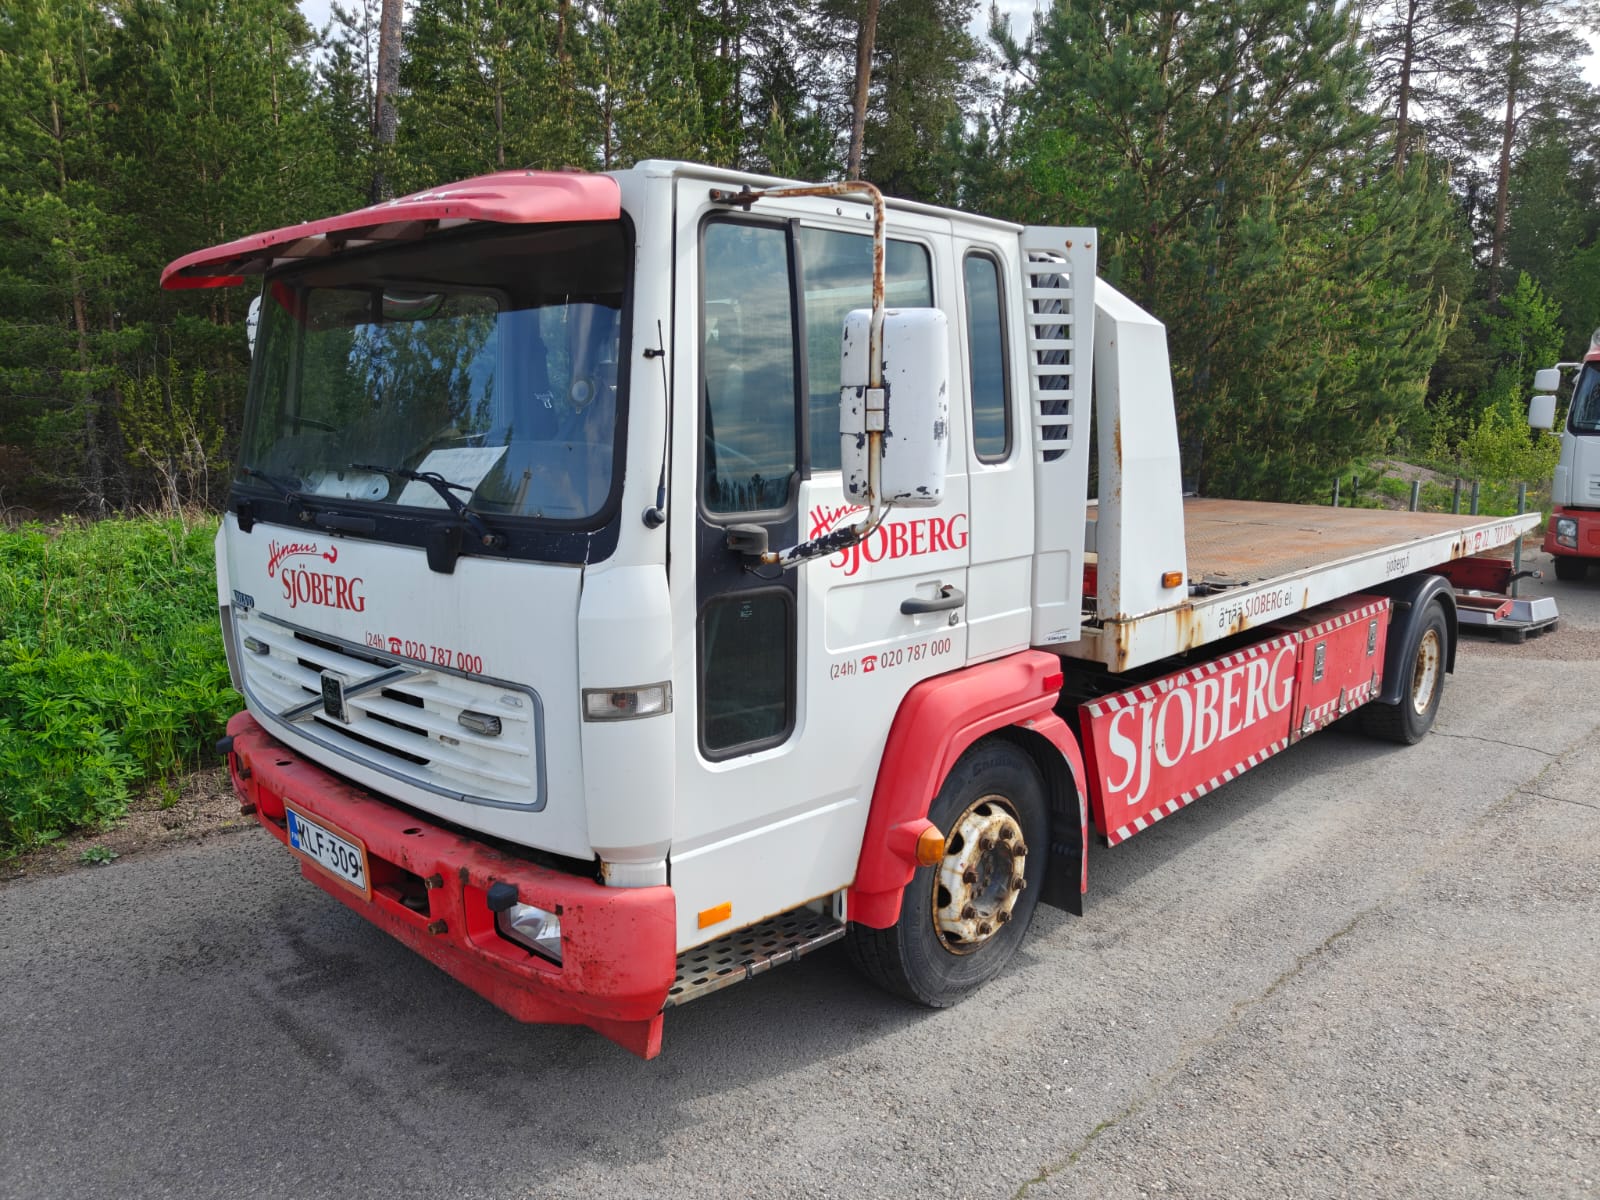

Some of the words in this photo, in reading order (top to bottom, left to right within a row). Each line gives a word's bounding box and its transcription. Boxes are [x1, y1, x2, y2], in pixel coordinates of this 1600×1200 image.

[268, 539, 317, 578] Hinaus
[281, 563, 365, 612] SJÖBERG
[365, 631, 386, 650] (24h)
[405, 640, 426, 662] 020
[430, 646, 452, 667] 787
[457, 652, 482, 674] 000
[830, 659, 857, 680] (24h)
[881, 648, 903, 669] 020
[907, 643, 927, 663] 787
[931, 638, 951, 657] 000
[1107, 644, 1296, 805] SJÖBERG
[297, 821, 359, 878] KLF-309
